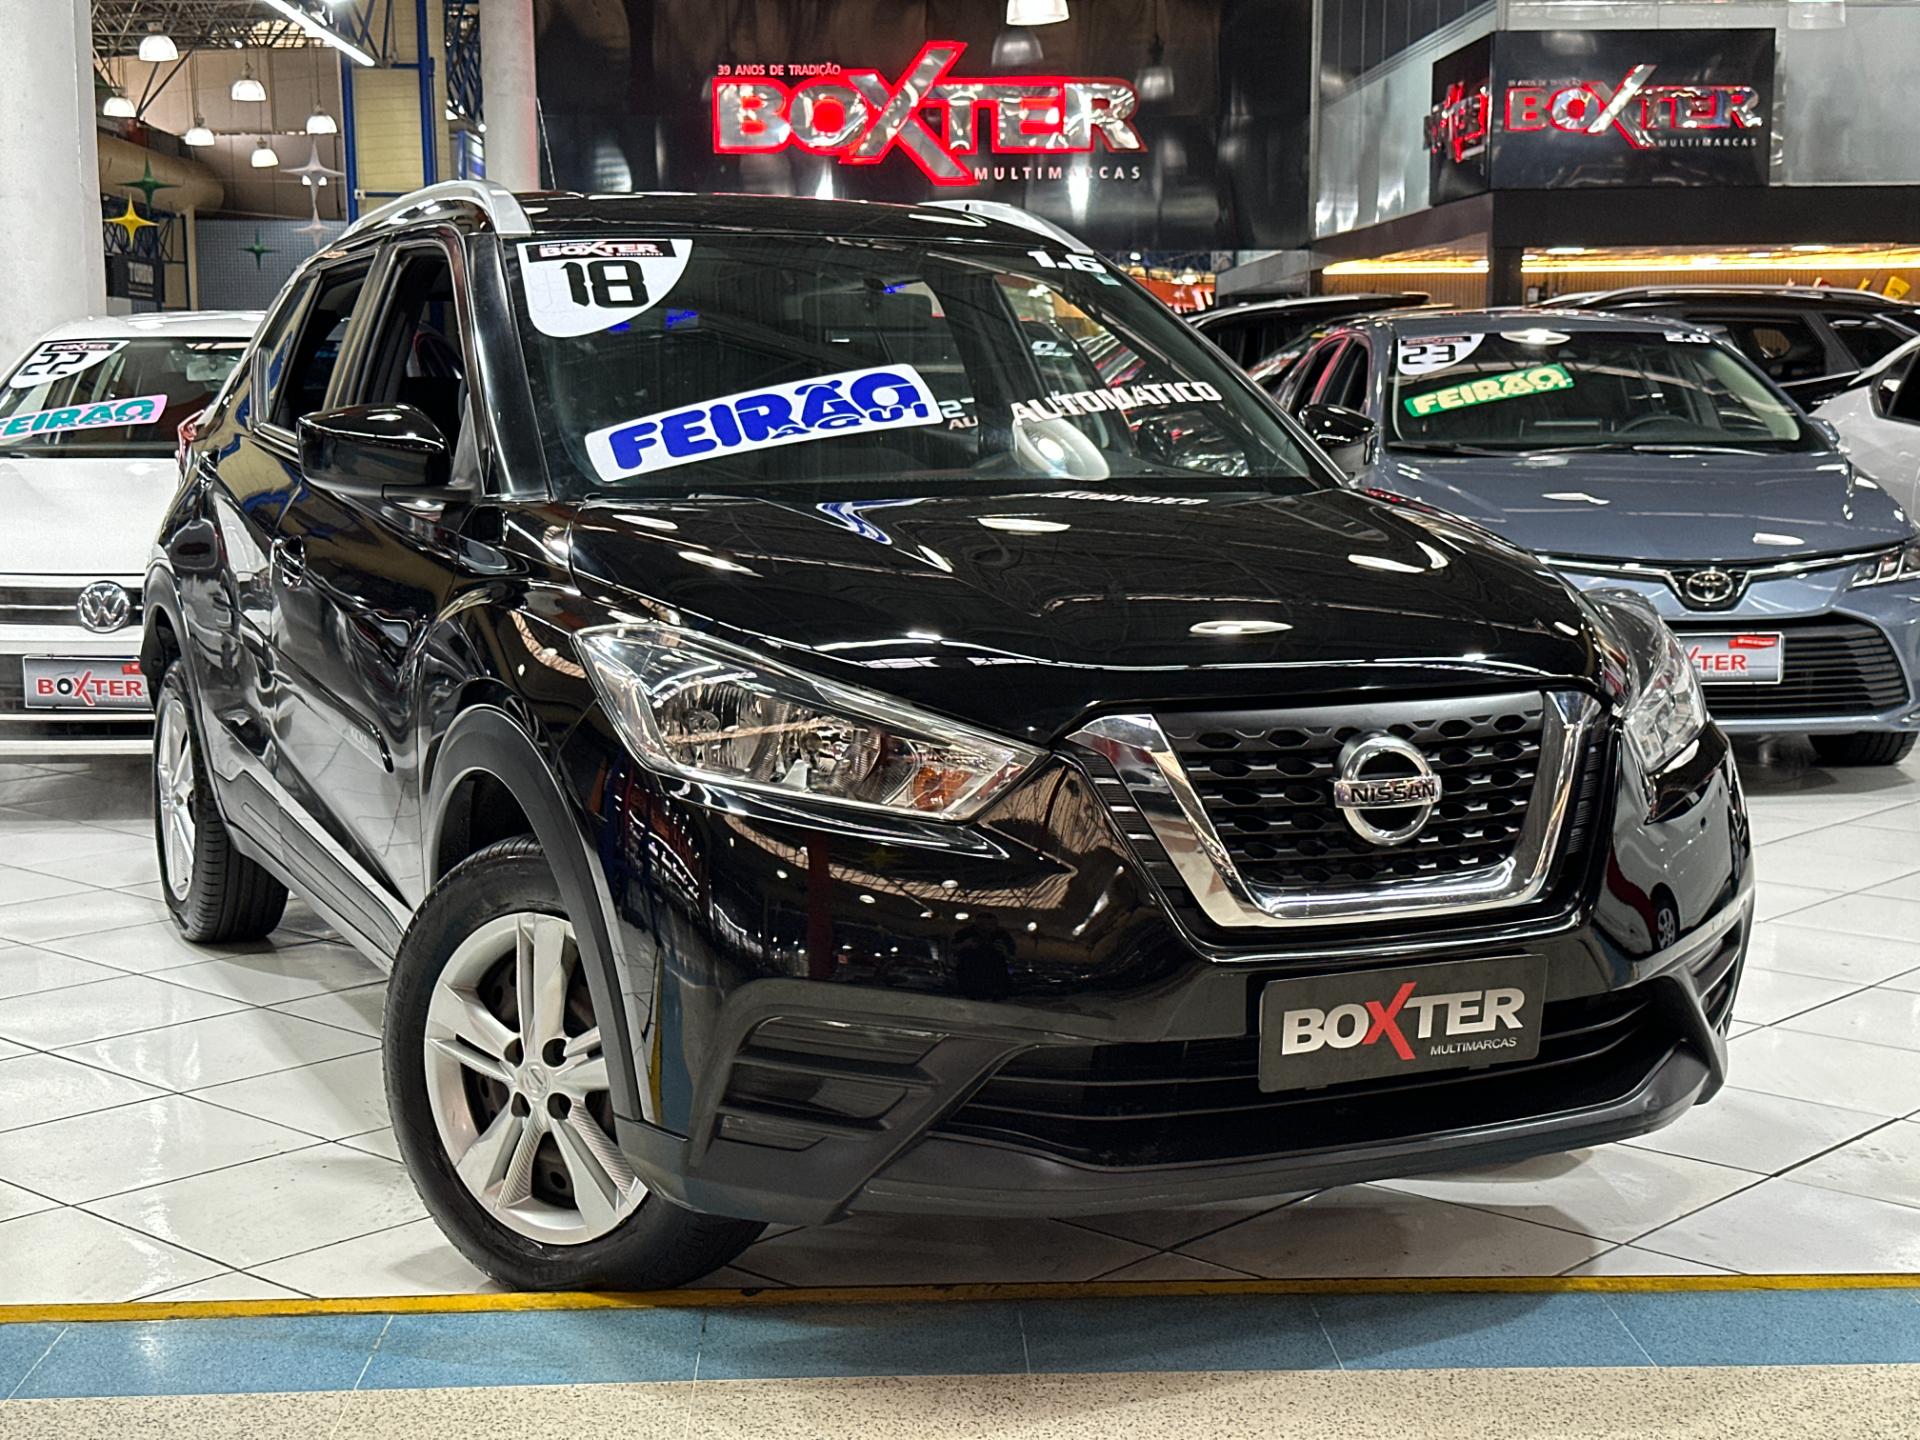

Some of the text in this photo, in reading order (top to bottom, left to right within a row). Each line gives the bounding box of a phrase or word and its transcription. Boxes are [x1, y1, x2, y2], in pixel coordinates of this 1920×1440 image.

[717, 62, 841, 76] 39 ANOS DE TRADIÇÃO
[712, 40, 1148, 186] BOXTER
[1505, 64, 1763, 149] BOXTER
[1658, 137, 1757, 148] MULTIMARCAS
[974, 166, 1141, 181] MULTIMARCAS
[539, 241, 661, 258] BOXTER
[1027, 250, 1107, 274] 1.6
[560, 260, 650, 309] 18
[20, 352, 88, 376] 22
[1402, 344, 1456, 365] 23
[1412, 366, 1566, 415] FEIRÃO
[608, 372, 921, 470] FEIRÃO
[770, 402, 929, 439] AQUI
[37, 671, 144, 706] BOXTER
[1351, 782, 1435, 803] NISSAN
[1281, 981, 1526, 1060] BOXTER
[1430, 1037, 1518, 1056] MULTIMARCAS
